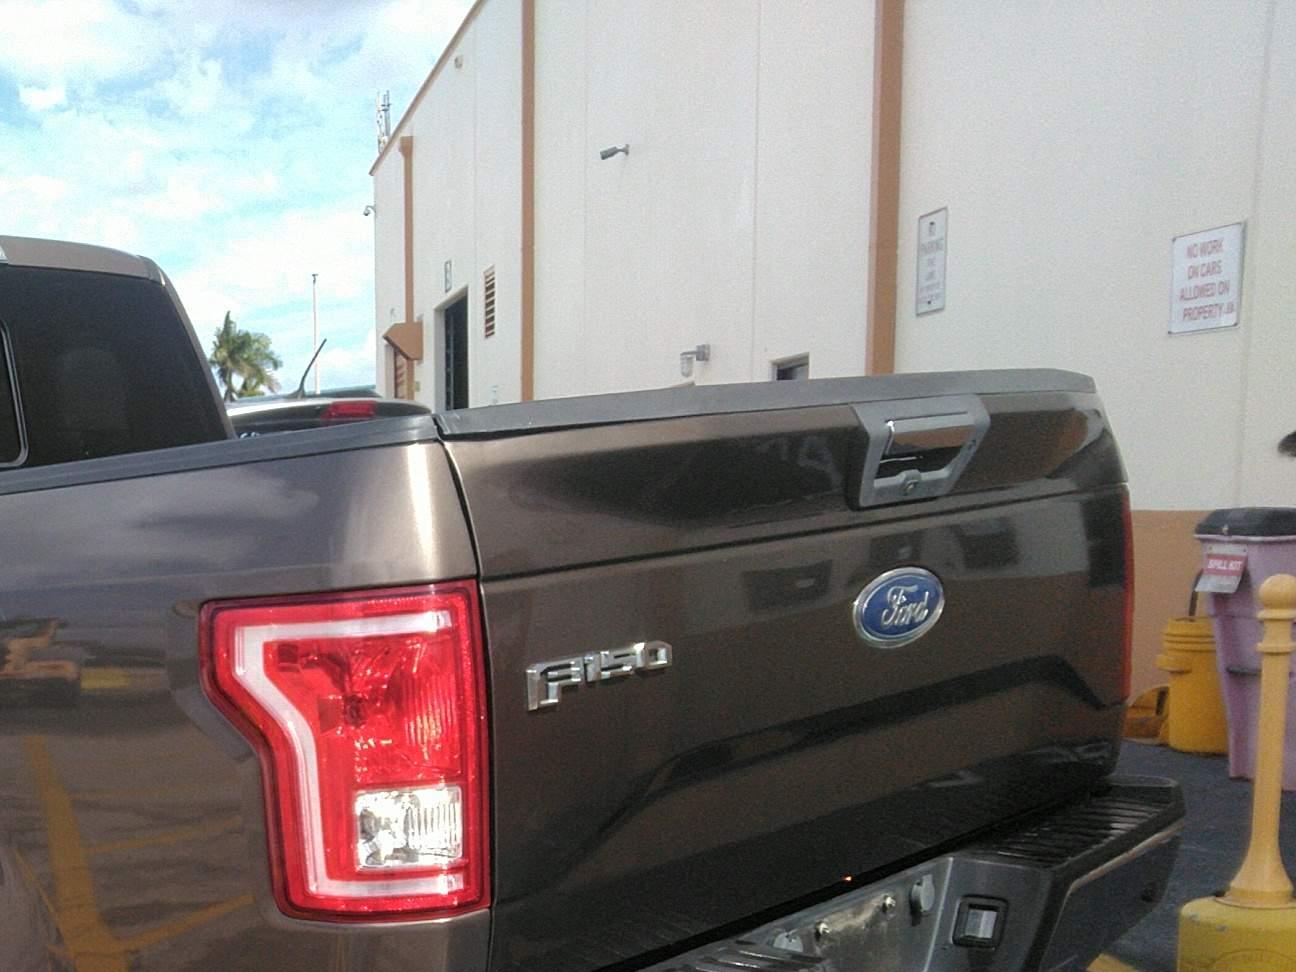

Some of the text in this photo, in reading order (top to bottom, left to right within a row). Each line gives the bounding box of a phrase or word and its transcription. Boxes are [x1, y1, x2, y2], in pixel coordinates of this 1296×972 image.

[1186, 239, 1224, 258] NO WORK
[1187, 260, 1223, 279] ON CARS
[1179, 280, 1230, 301] ALLOWED ON
[1182, 303, 1224, 321] PROPERTY
[1207, 559, 1227, 570] SPILL
[880, 584, 930, 630] Ford
